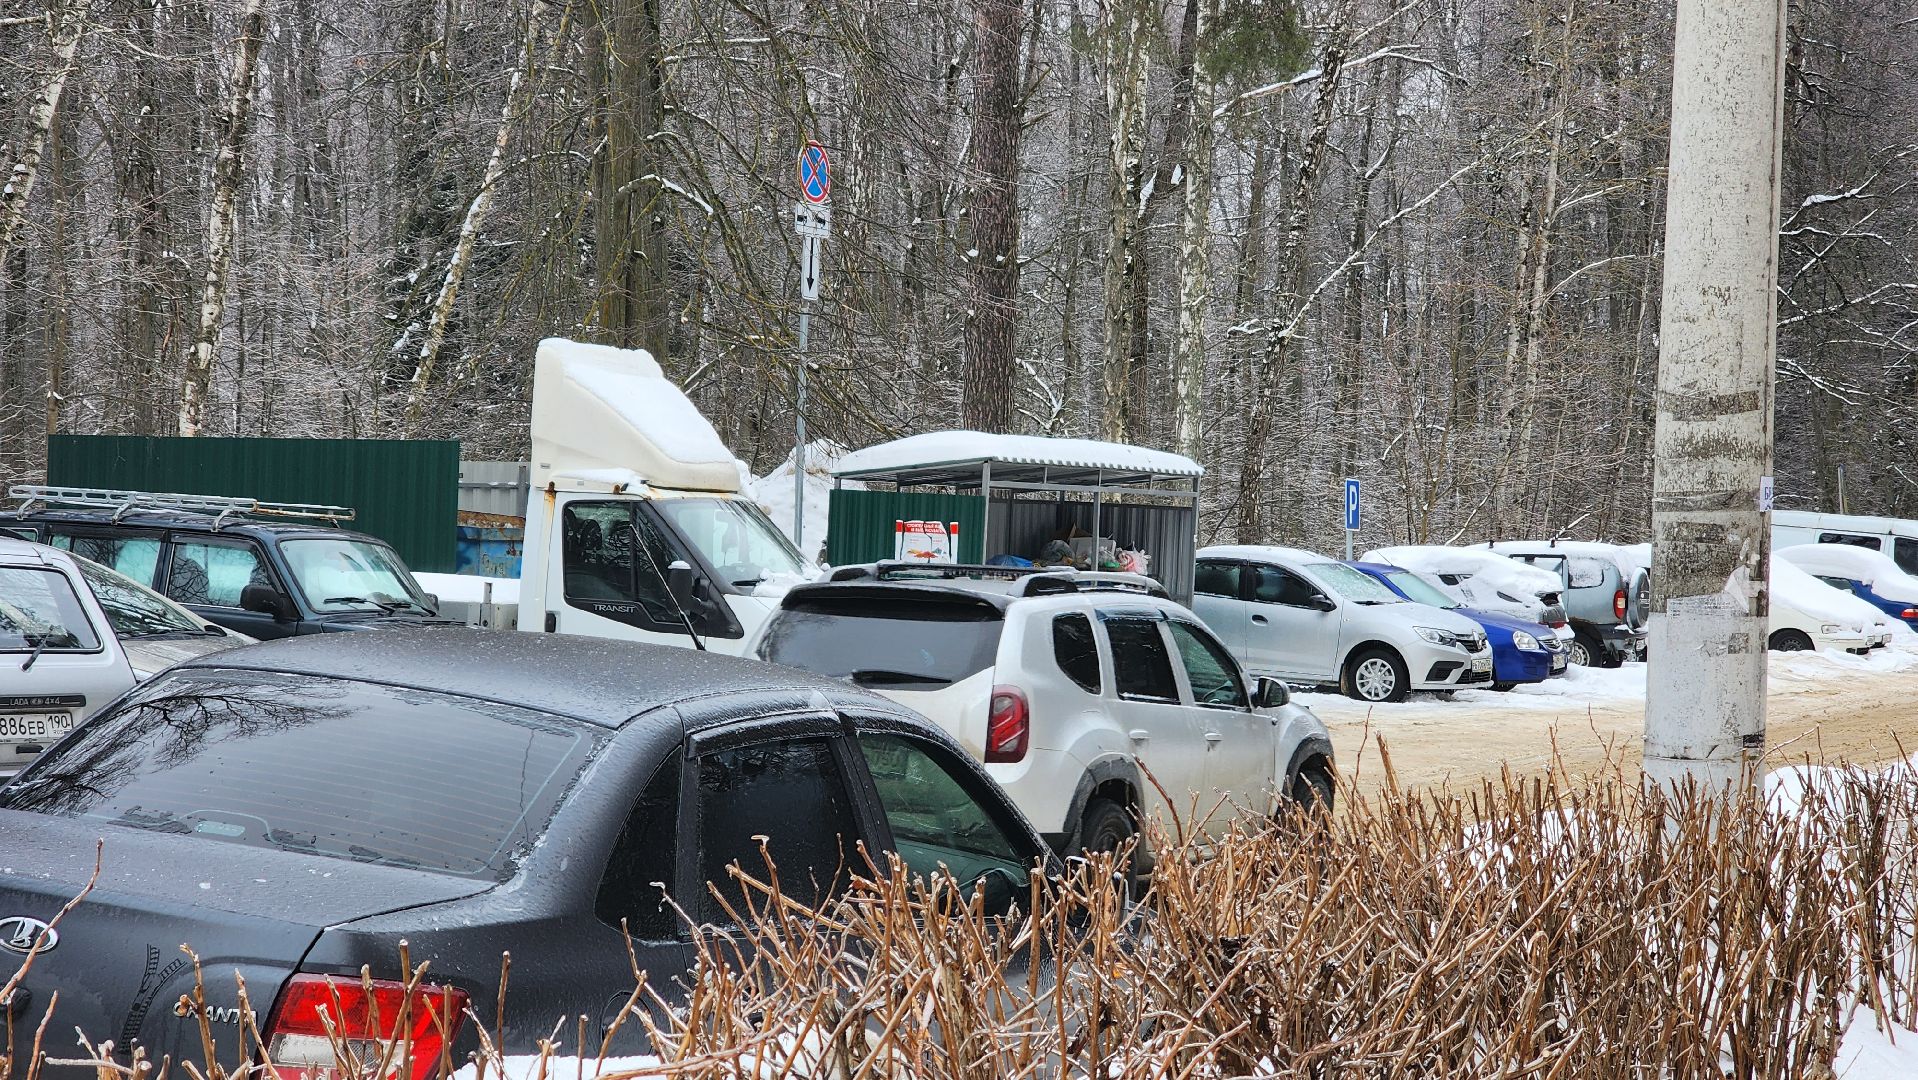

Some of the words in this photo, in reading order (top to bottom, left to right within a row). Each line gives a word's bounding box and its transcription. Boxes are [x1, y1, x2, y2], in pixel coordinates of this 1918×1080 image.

[1349, 485, 1358, 524] P
[593, 604, 636, 613] TRANSIT
[10, 698, 29, 706] LADA
[48, 715, 67, 728] 190
